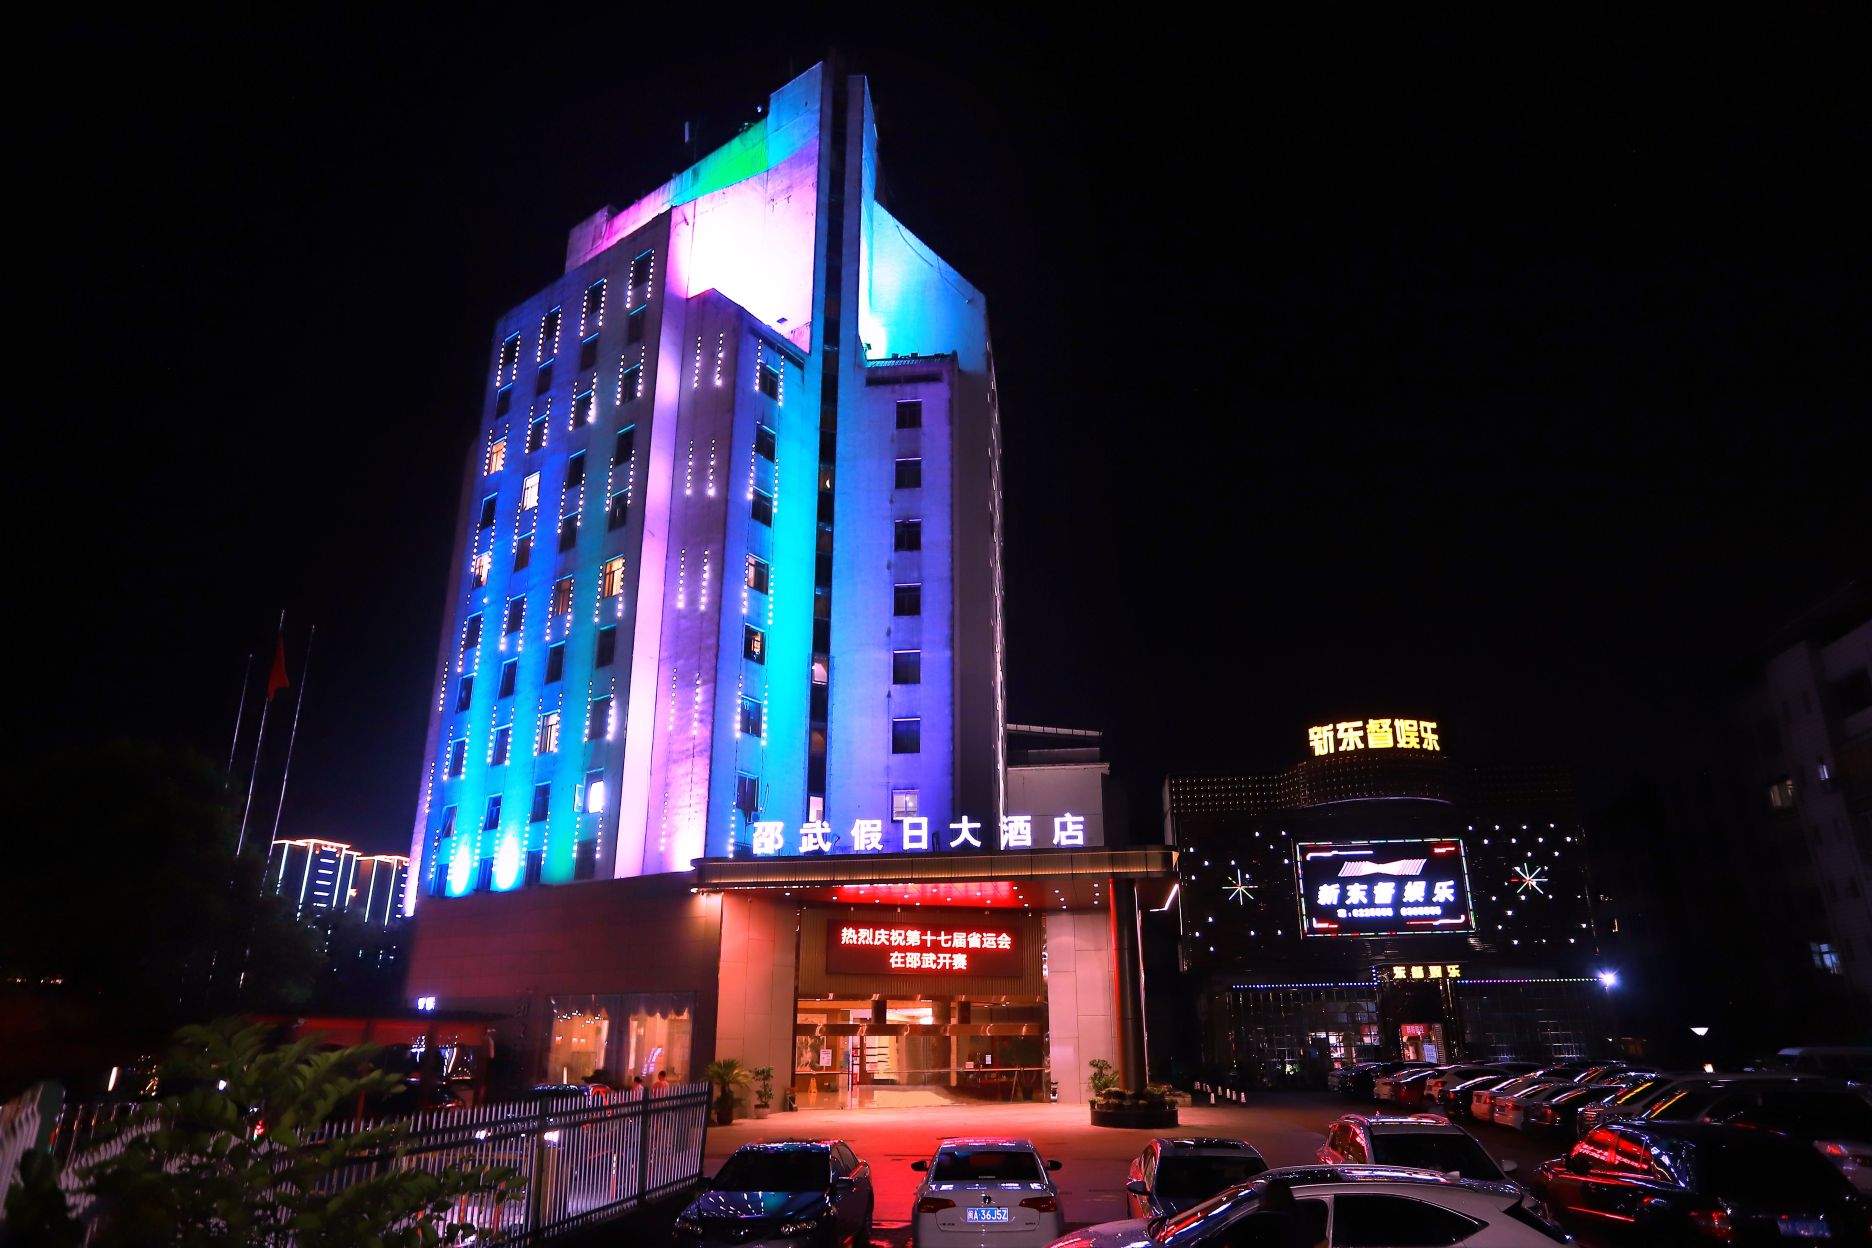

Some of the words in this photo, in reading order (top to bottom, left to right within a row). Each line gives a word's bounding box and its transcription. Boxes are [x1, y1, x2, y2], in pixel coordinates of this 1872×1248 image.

[1308, 718, 1440, 756] 新东督娱乐
[752, 812, 1084, 854] 邵武假日大酒店
[841, 927, 1012, 949] 热烈庆祝第十七届省运会
[889, 951, 967, 970] 在邵武开赛
